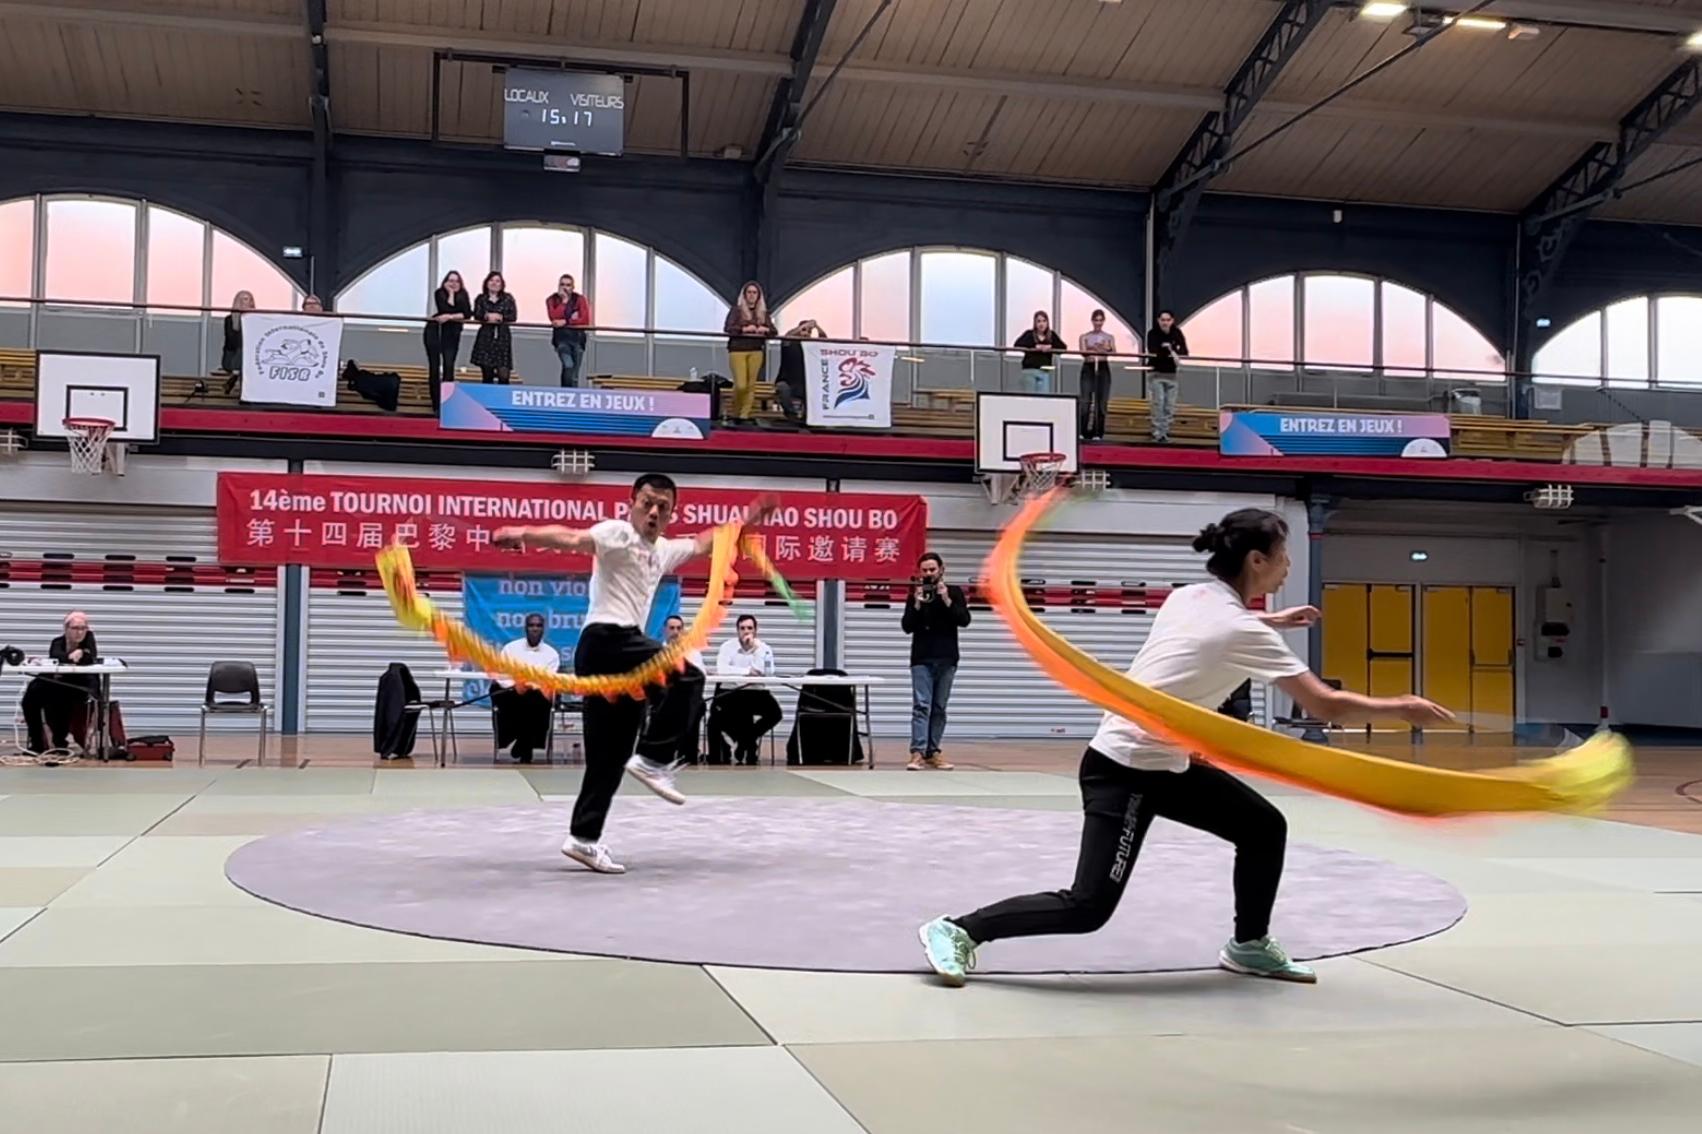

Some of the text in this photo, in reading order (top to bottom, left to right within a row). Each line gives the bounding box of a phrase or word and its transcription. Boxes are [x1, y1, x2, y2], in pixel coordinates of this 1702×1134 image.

[504, 88, 624, 109] LOCAUX VISITEURS
[860, 350, 879, 358] BO
[821, 359, 829, 410] FRANCE
[511, 390, 576, 408] ENTREZ
[580, 393, 601, 409] EN
[605, 394, 645, 411] JEUX
[1280, 417, 1335, 433] ENTREZ
[1338, 419, 1357, 433] EN
[1360, 419, 1395, 433] JEUX
[250, 489, 326, 512] 14ème
[330, 491, 432, 515] TOURNOI
[438, 495, 609, 521] INTERNATIONAL
[804, 507, 862, 528] SHOU
[868, 508, 898, 529] BO
[499, 580, 545, 595] non
